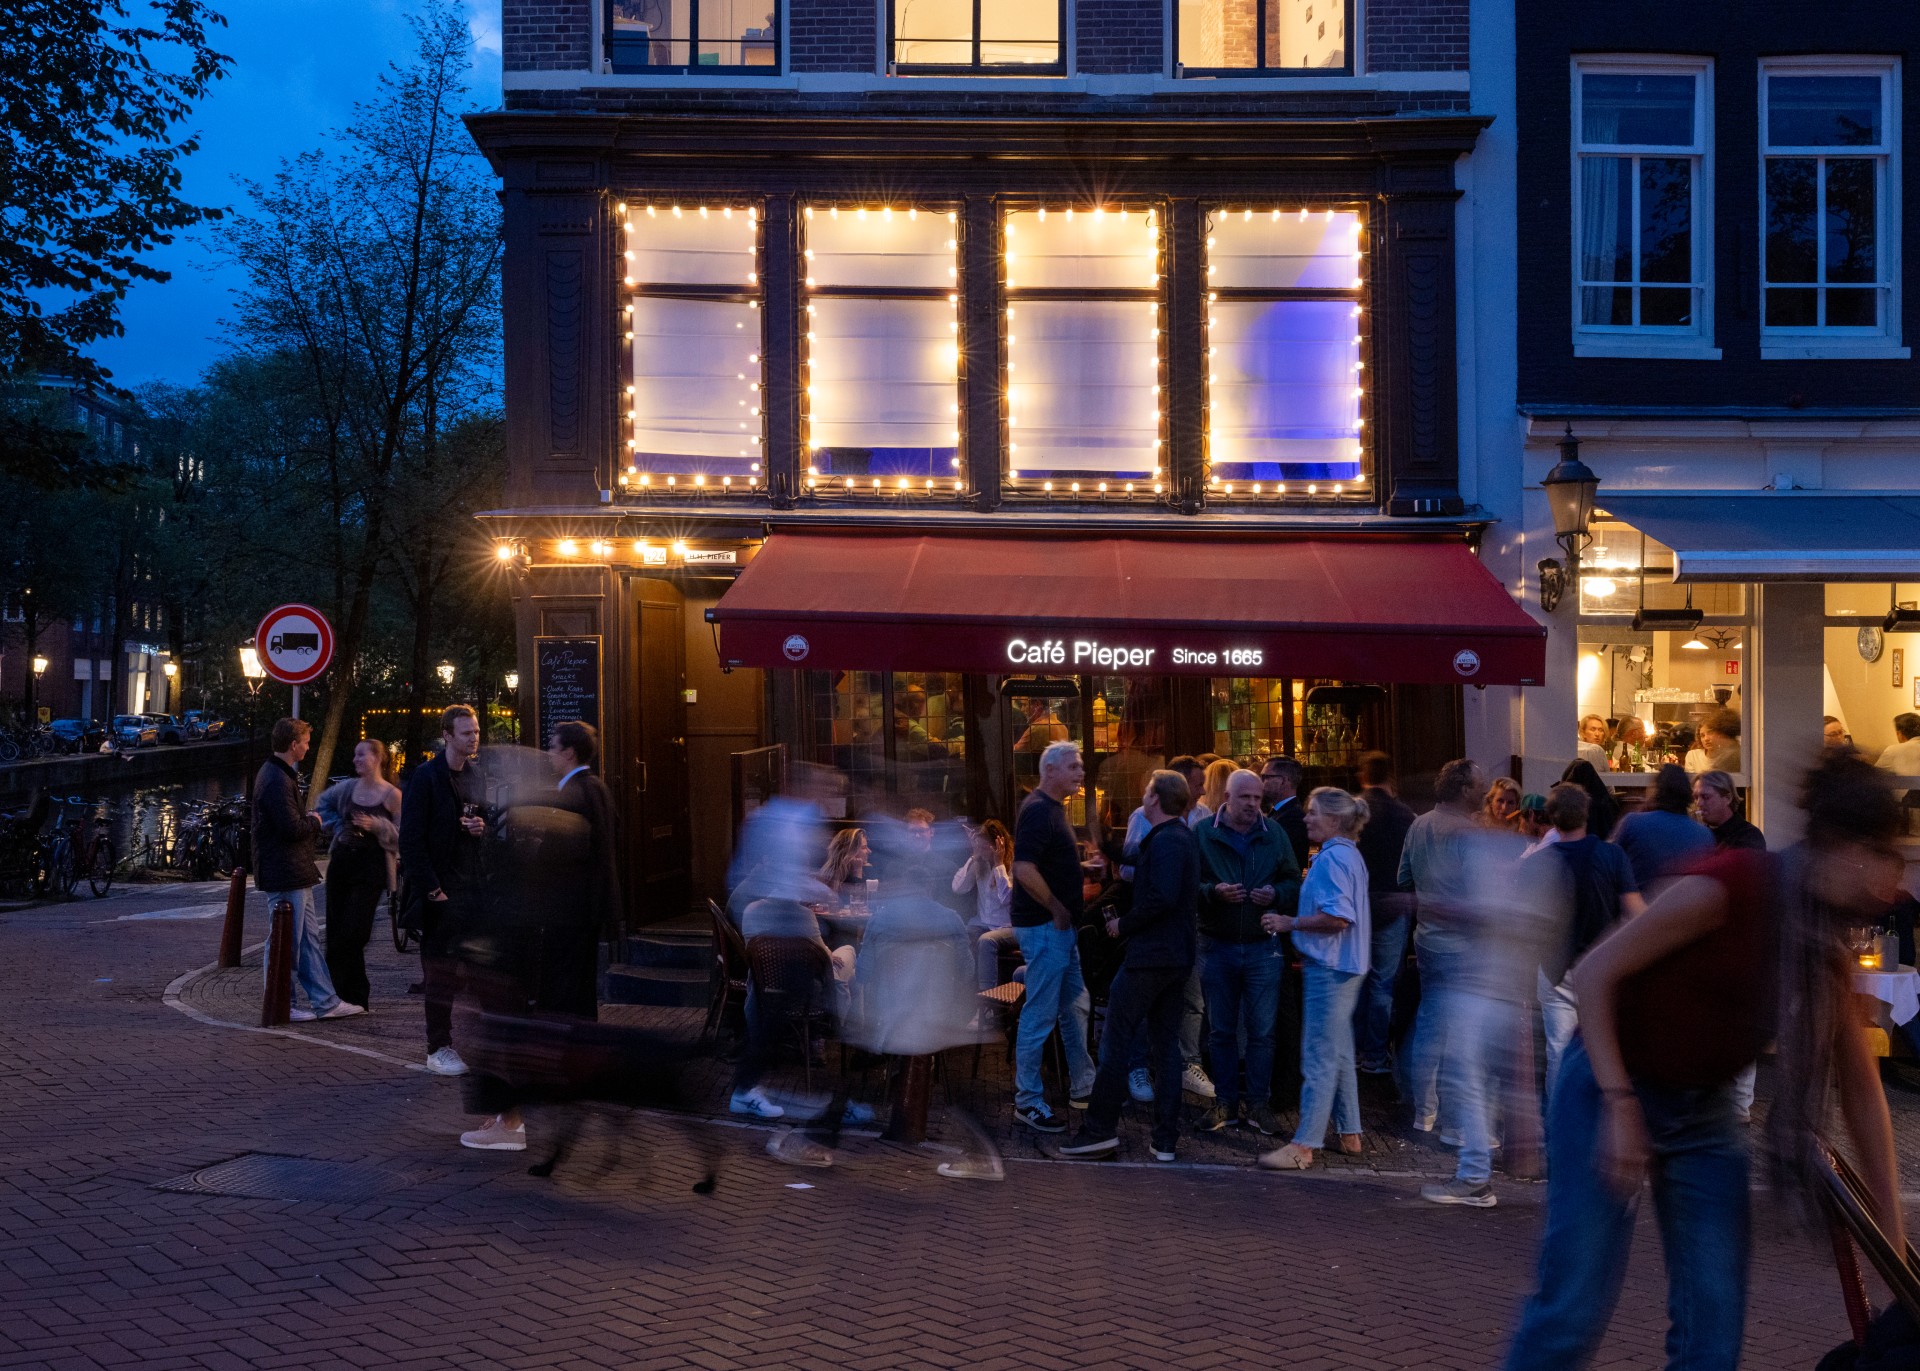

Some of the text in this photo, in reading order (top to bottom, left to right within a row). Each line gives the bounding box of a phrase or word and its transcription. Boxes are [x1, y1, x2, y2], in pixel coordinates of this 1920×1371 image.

[707, 553, 731, 561] PIEPER
[541, 651, 563, 670] Café
[1006, 639, 1263, 670] Café Pieper Since 1665
